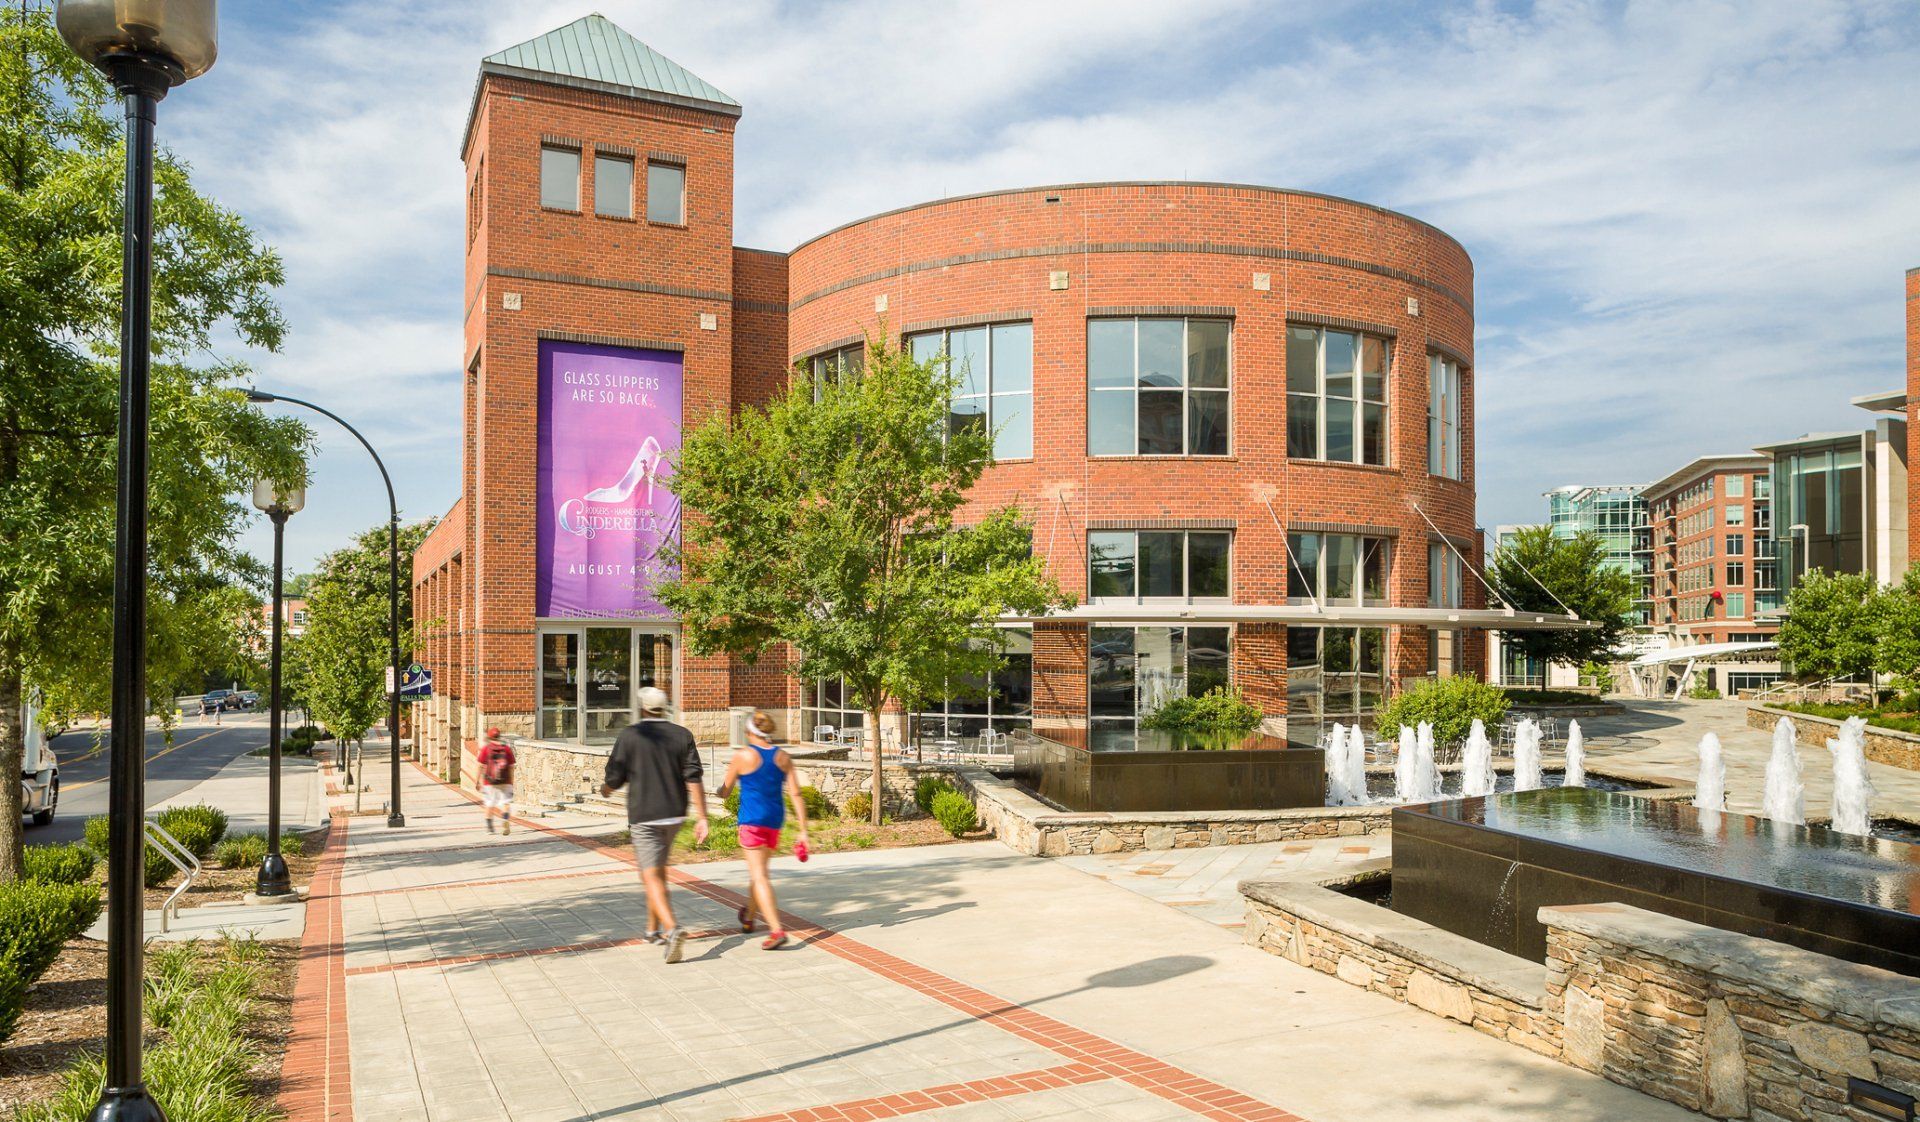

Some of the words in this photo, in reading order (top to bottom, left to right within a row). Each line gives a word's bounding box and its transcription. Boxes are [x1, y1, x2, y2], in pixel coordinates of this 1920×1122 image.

[564, 371, 600, 386] GLASS
[605, 374, 659, 391] SLIPPERS
[572, 389, 594, 402] ARE
[600, 391, 614, 404] SO
[558, 498, 658, 540] CINDERELLA
[568, 564, 621, 576] AUGUST
[629, 565, 649, 576] 49
